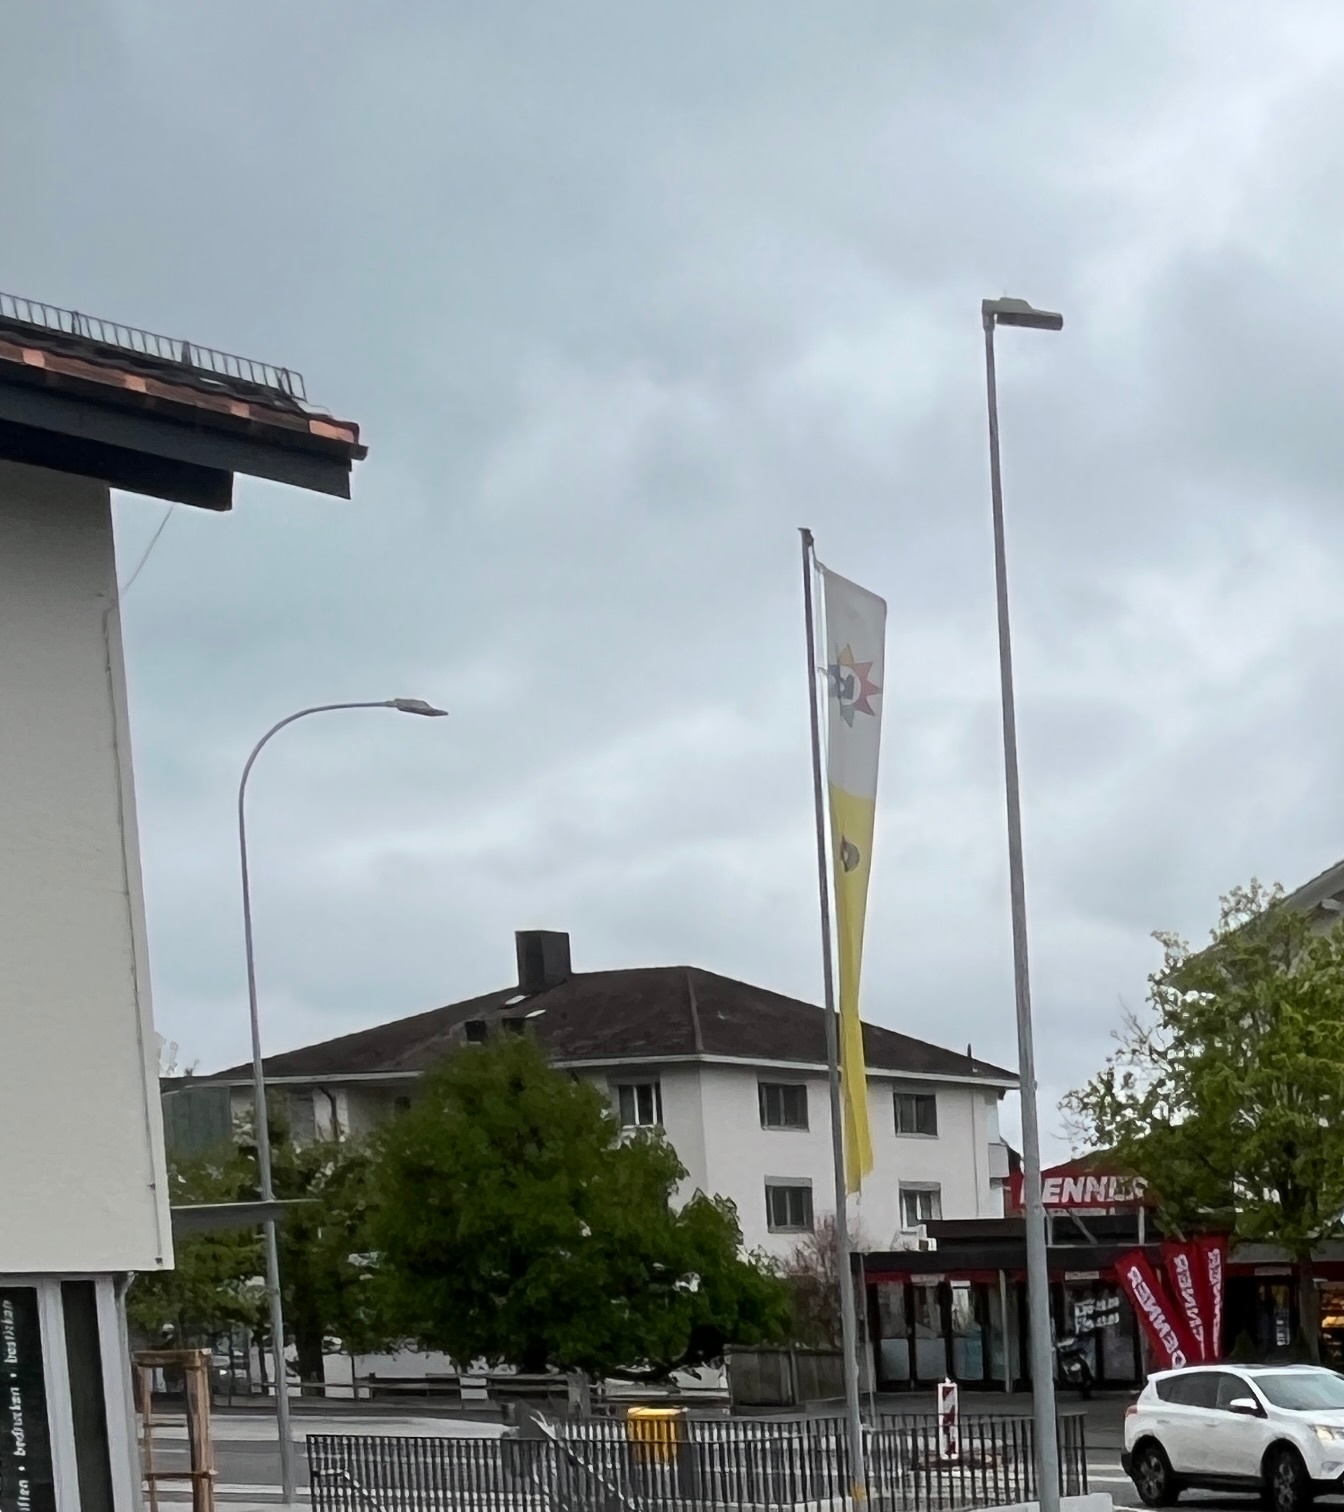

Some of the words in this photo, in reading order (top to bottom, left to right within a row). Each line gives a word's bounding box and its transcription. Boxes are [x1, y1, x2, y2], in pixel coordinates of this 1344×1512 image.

[1020, 1175, 1148, 1204] ENNER
[1127, 1266, 1187, 1370] DENNER
[1174, 1254, 1205, 1360] ENNER
